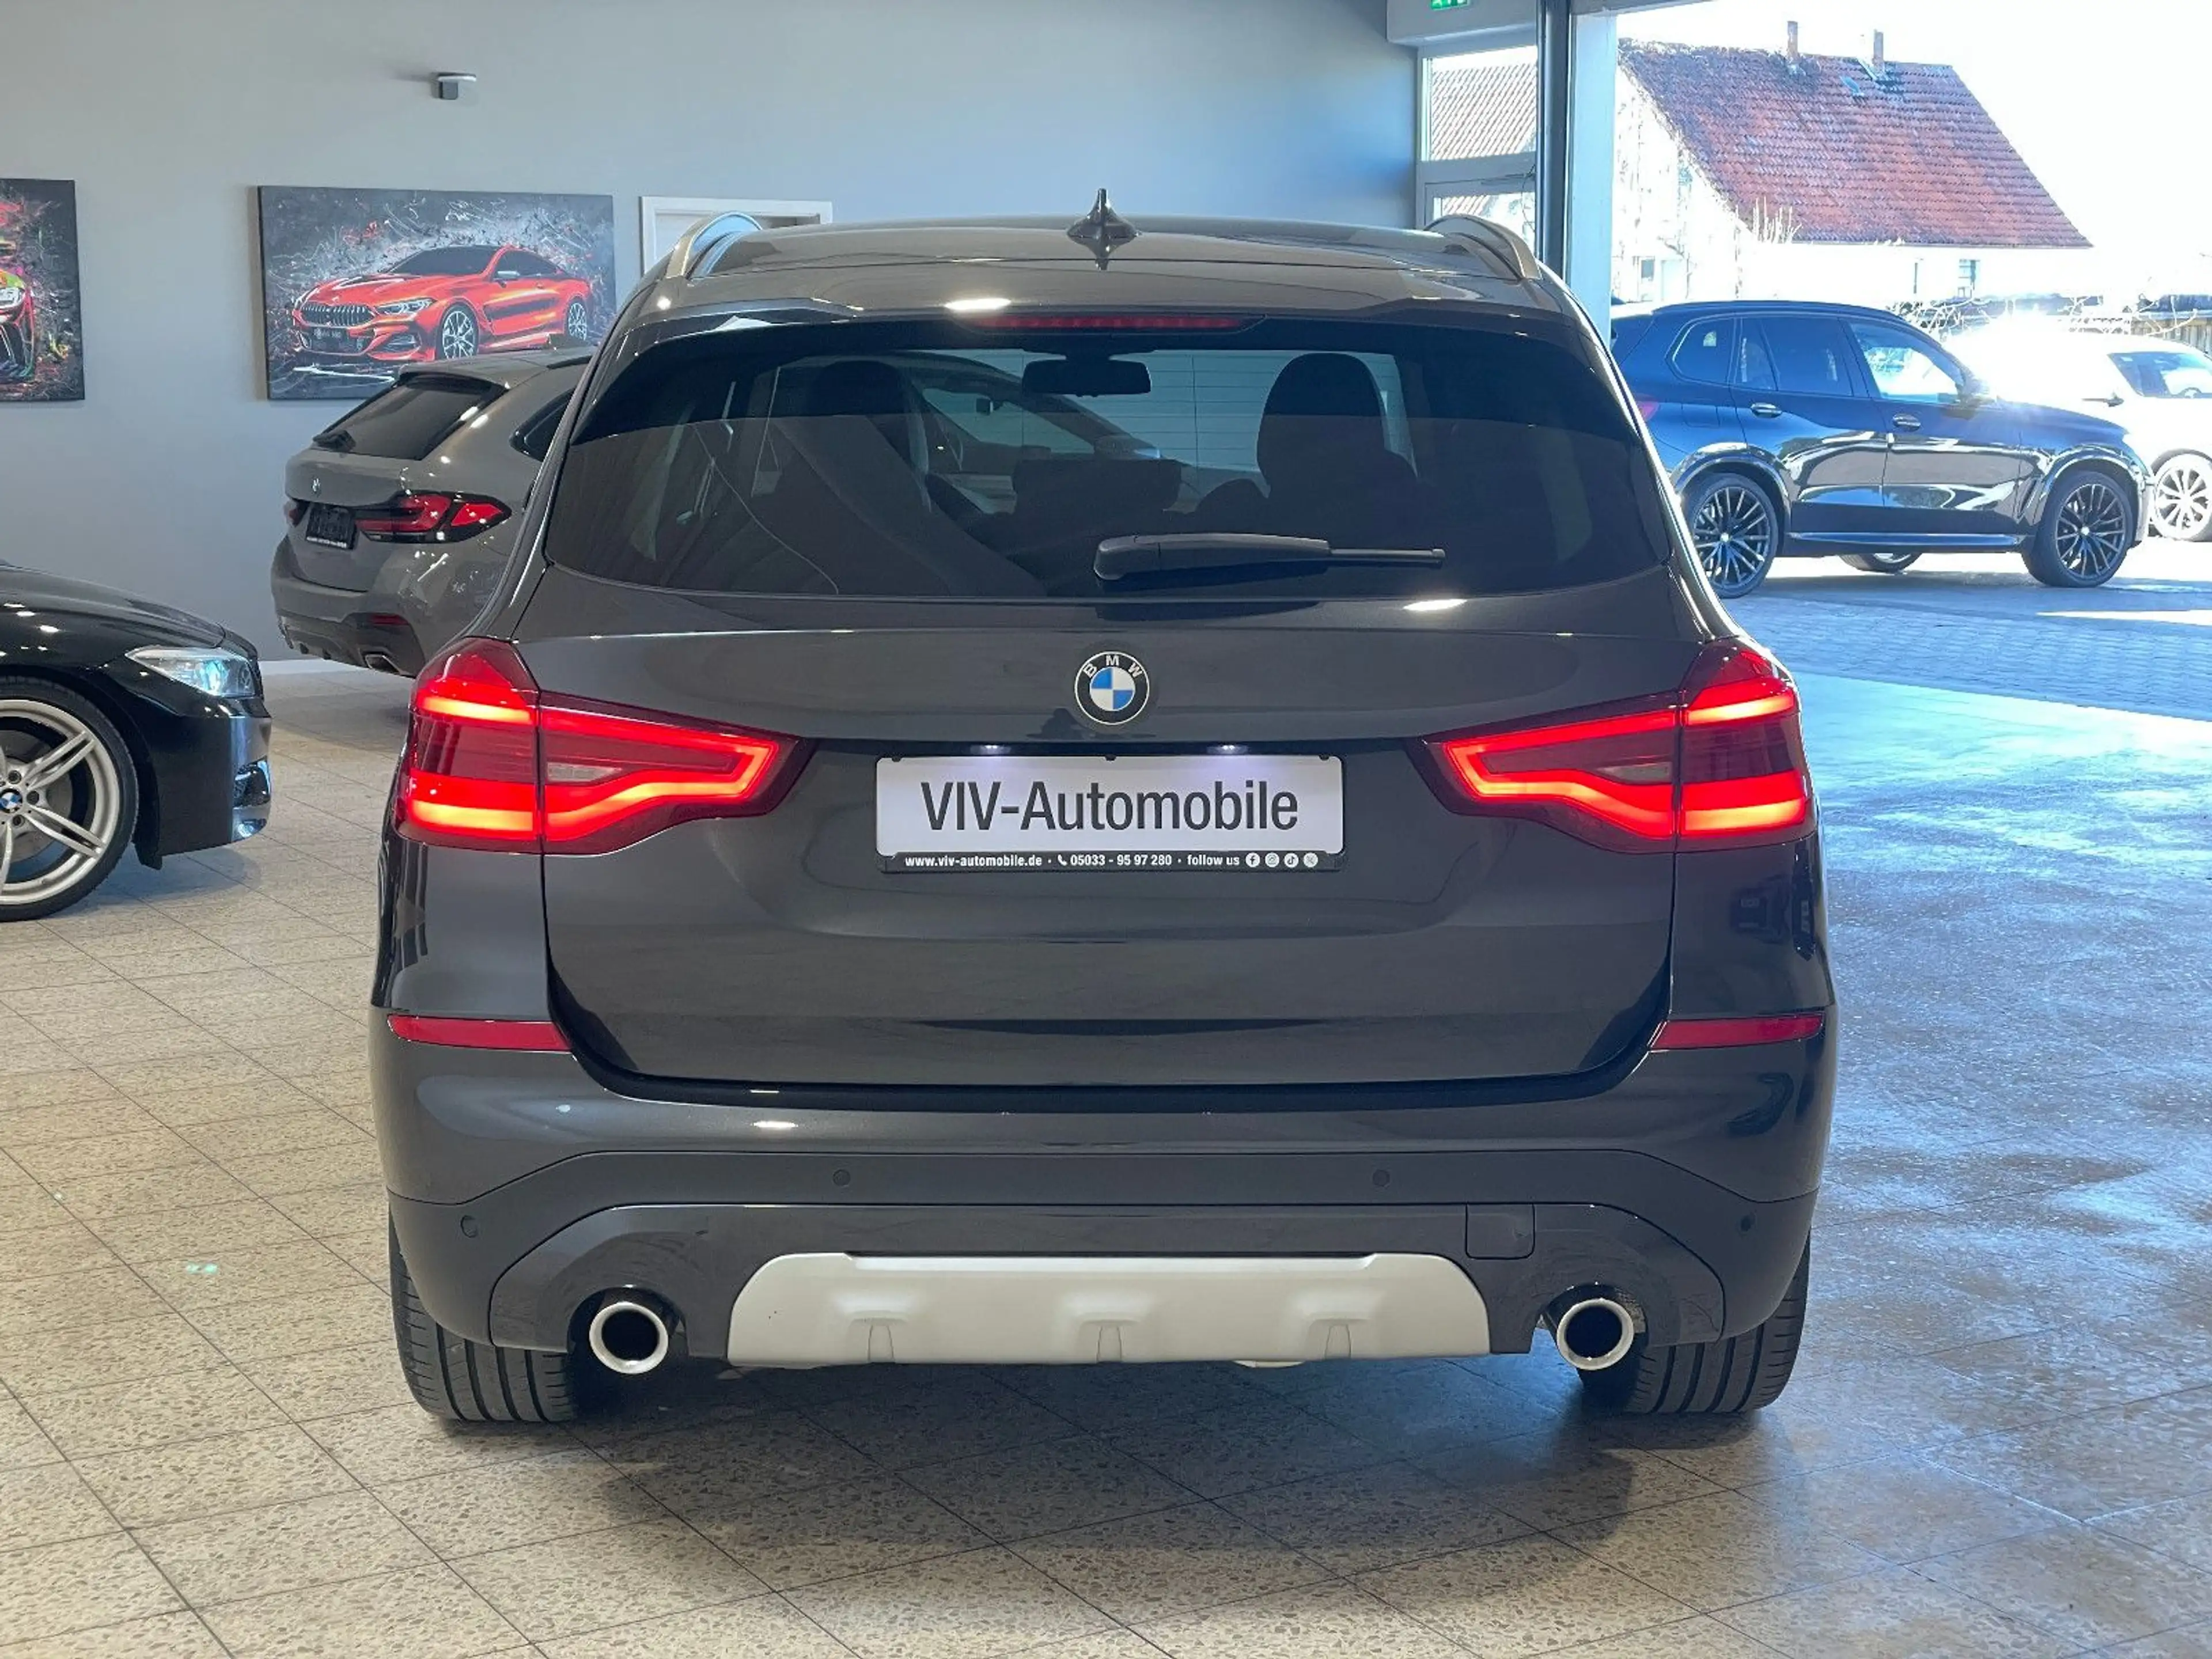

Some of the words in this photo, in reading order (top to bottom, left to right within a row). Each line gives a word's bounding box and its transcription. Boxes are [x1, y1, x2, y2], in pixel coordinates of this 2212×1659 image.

[1082, 655, 1143, 678] BMW
[921, 781, 1298, 830] VIV-Automobile
[905, 854, 1042, 866] www.viv-automobile.de
[1070, 854, 1105, 866] 05033
[1116, 854, 1131, 866] 95
[1134, 854, 1148, 866] 97
[1151, 854, 1172, 866] 280
[1187, 854, 1223, 865] follow
[1226, 856, 1240, 865] us
